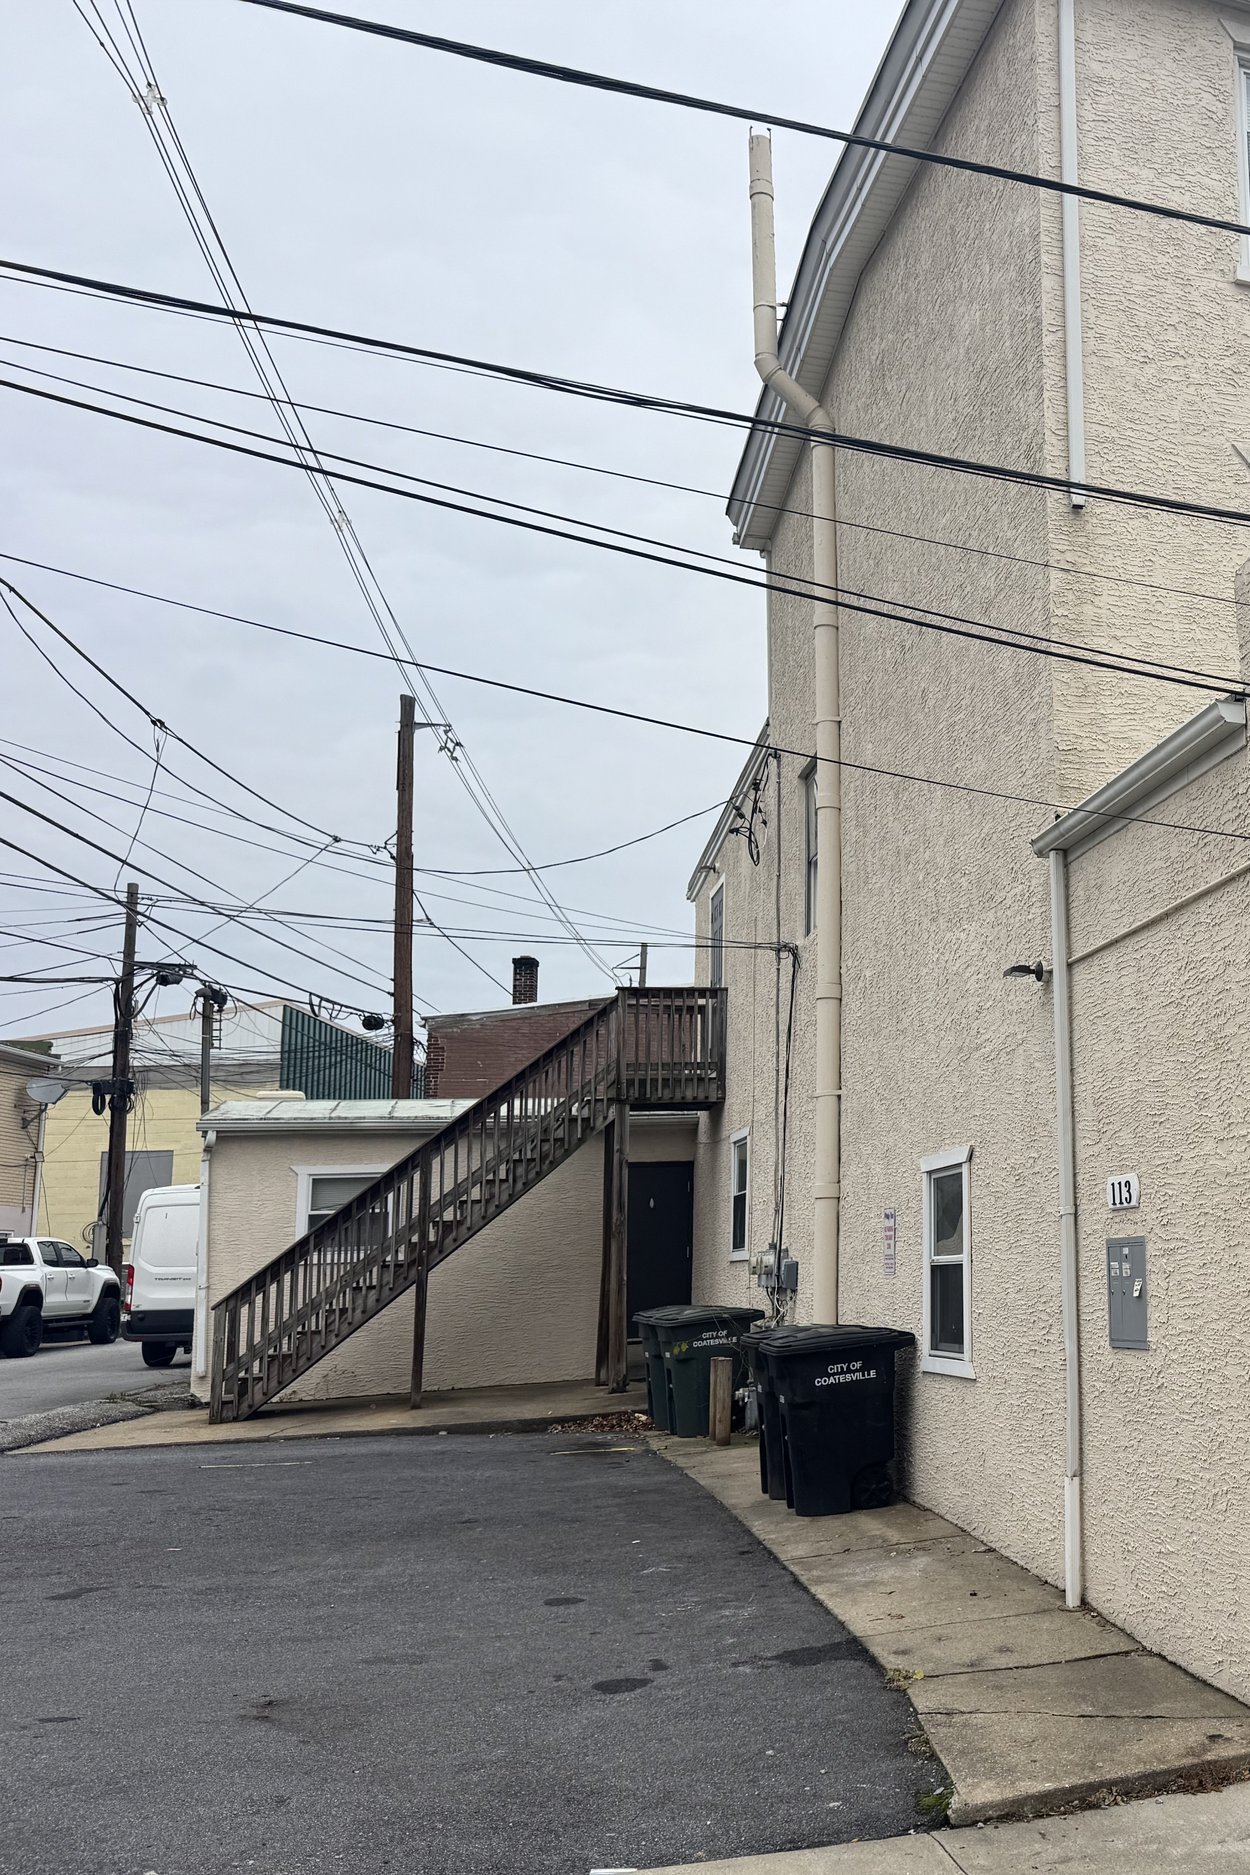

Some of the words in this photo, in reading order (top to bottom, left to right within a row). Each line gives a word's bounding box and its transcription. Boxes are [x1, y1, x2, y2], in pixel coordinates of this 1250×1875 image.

[1111, 1180, 1132, 1206] 113
[702, 1331, 717, 1339] CITY
[718, 1330, 728, 1338] OF
[827, 1362, 848, 1374] CITY
[849, 1361, 863, 1371] OF
[814, 1370, 877, 1387] COATESVILLE
